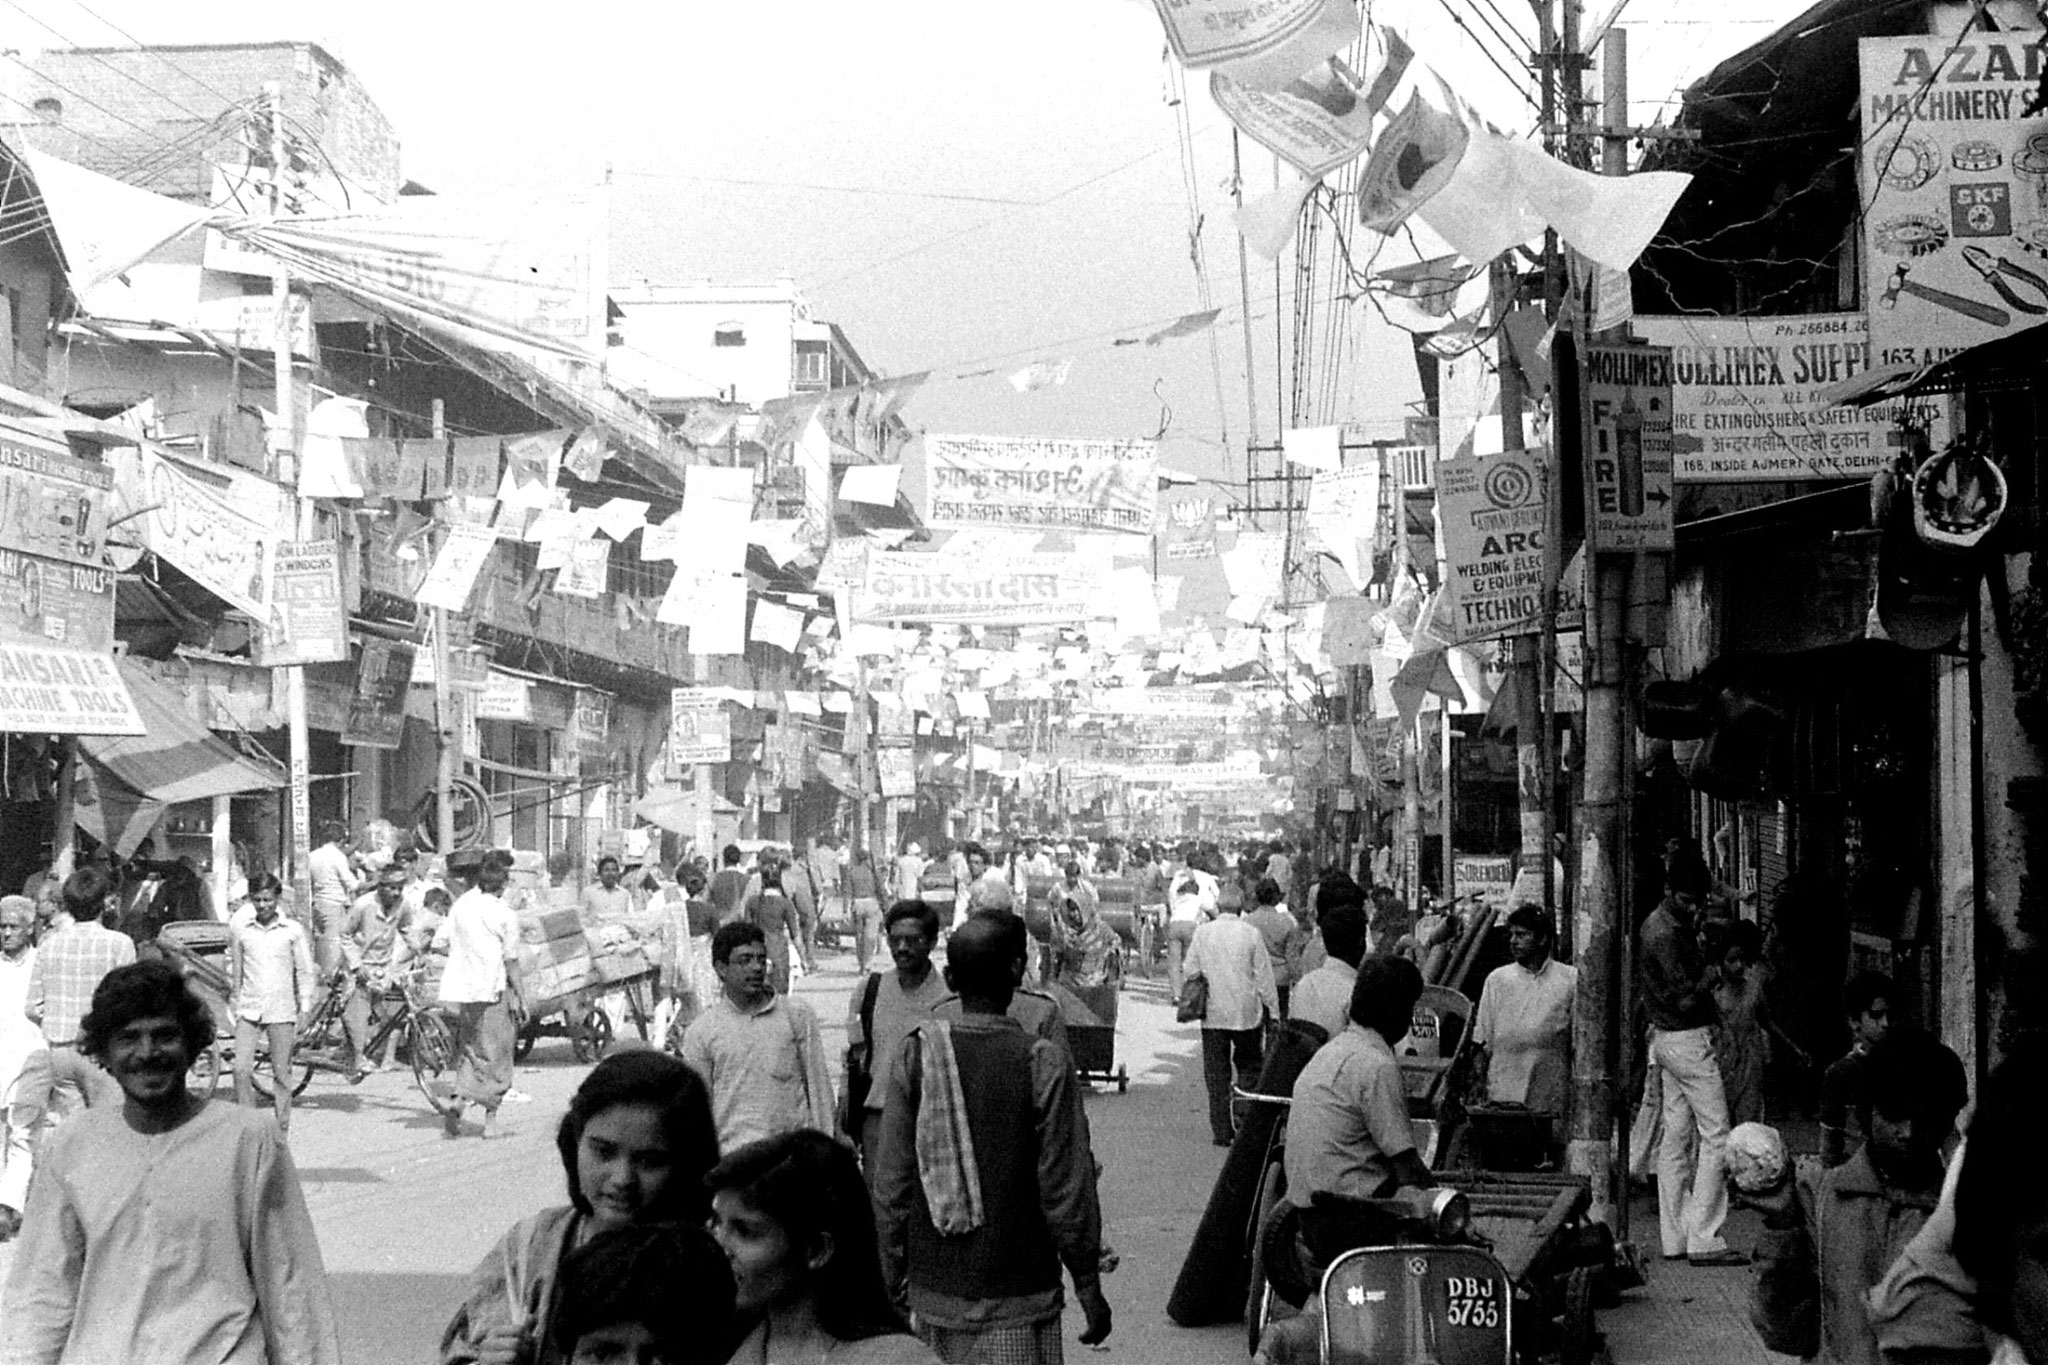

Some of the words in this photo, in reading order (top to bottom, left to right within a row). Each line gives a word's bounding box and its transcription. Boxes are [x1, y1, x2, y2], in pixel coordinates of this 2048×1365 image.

[1871, 89, 2013, 123] MACHINERY
[1957, 187, 2003, 204] SKF
[1588, 350, 1671, 388] MOLLIMEX
[1881, 348, 1915, 366] 163
[1704, 411, 1806, 430] EXTINGUISHERS
[1818, 405, 1861, 426] SAFETY
[1593, 400, 1618, 513] FIRE
[1711, 460, 1748, 472] INSIDE
[1753, 458, 1802, 471] AJMERI
[1481, 530, 1545, 558] ARC
[1456, 559, 1510, 578] WELDING
[1461, 596, 1534, 624] TECHNO
[70, 689, 129, 714] TOOLS
[1448, 1277, 1493, 1298] DBJ
